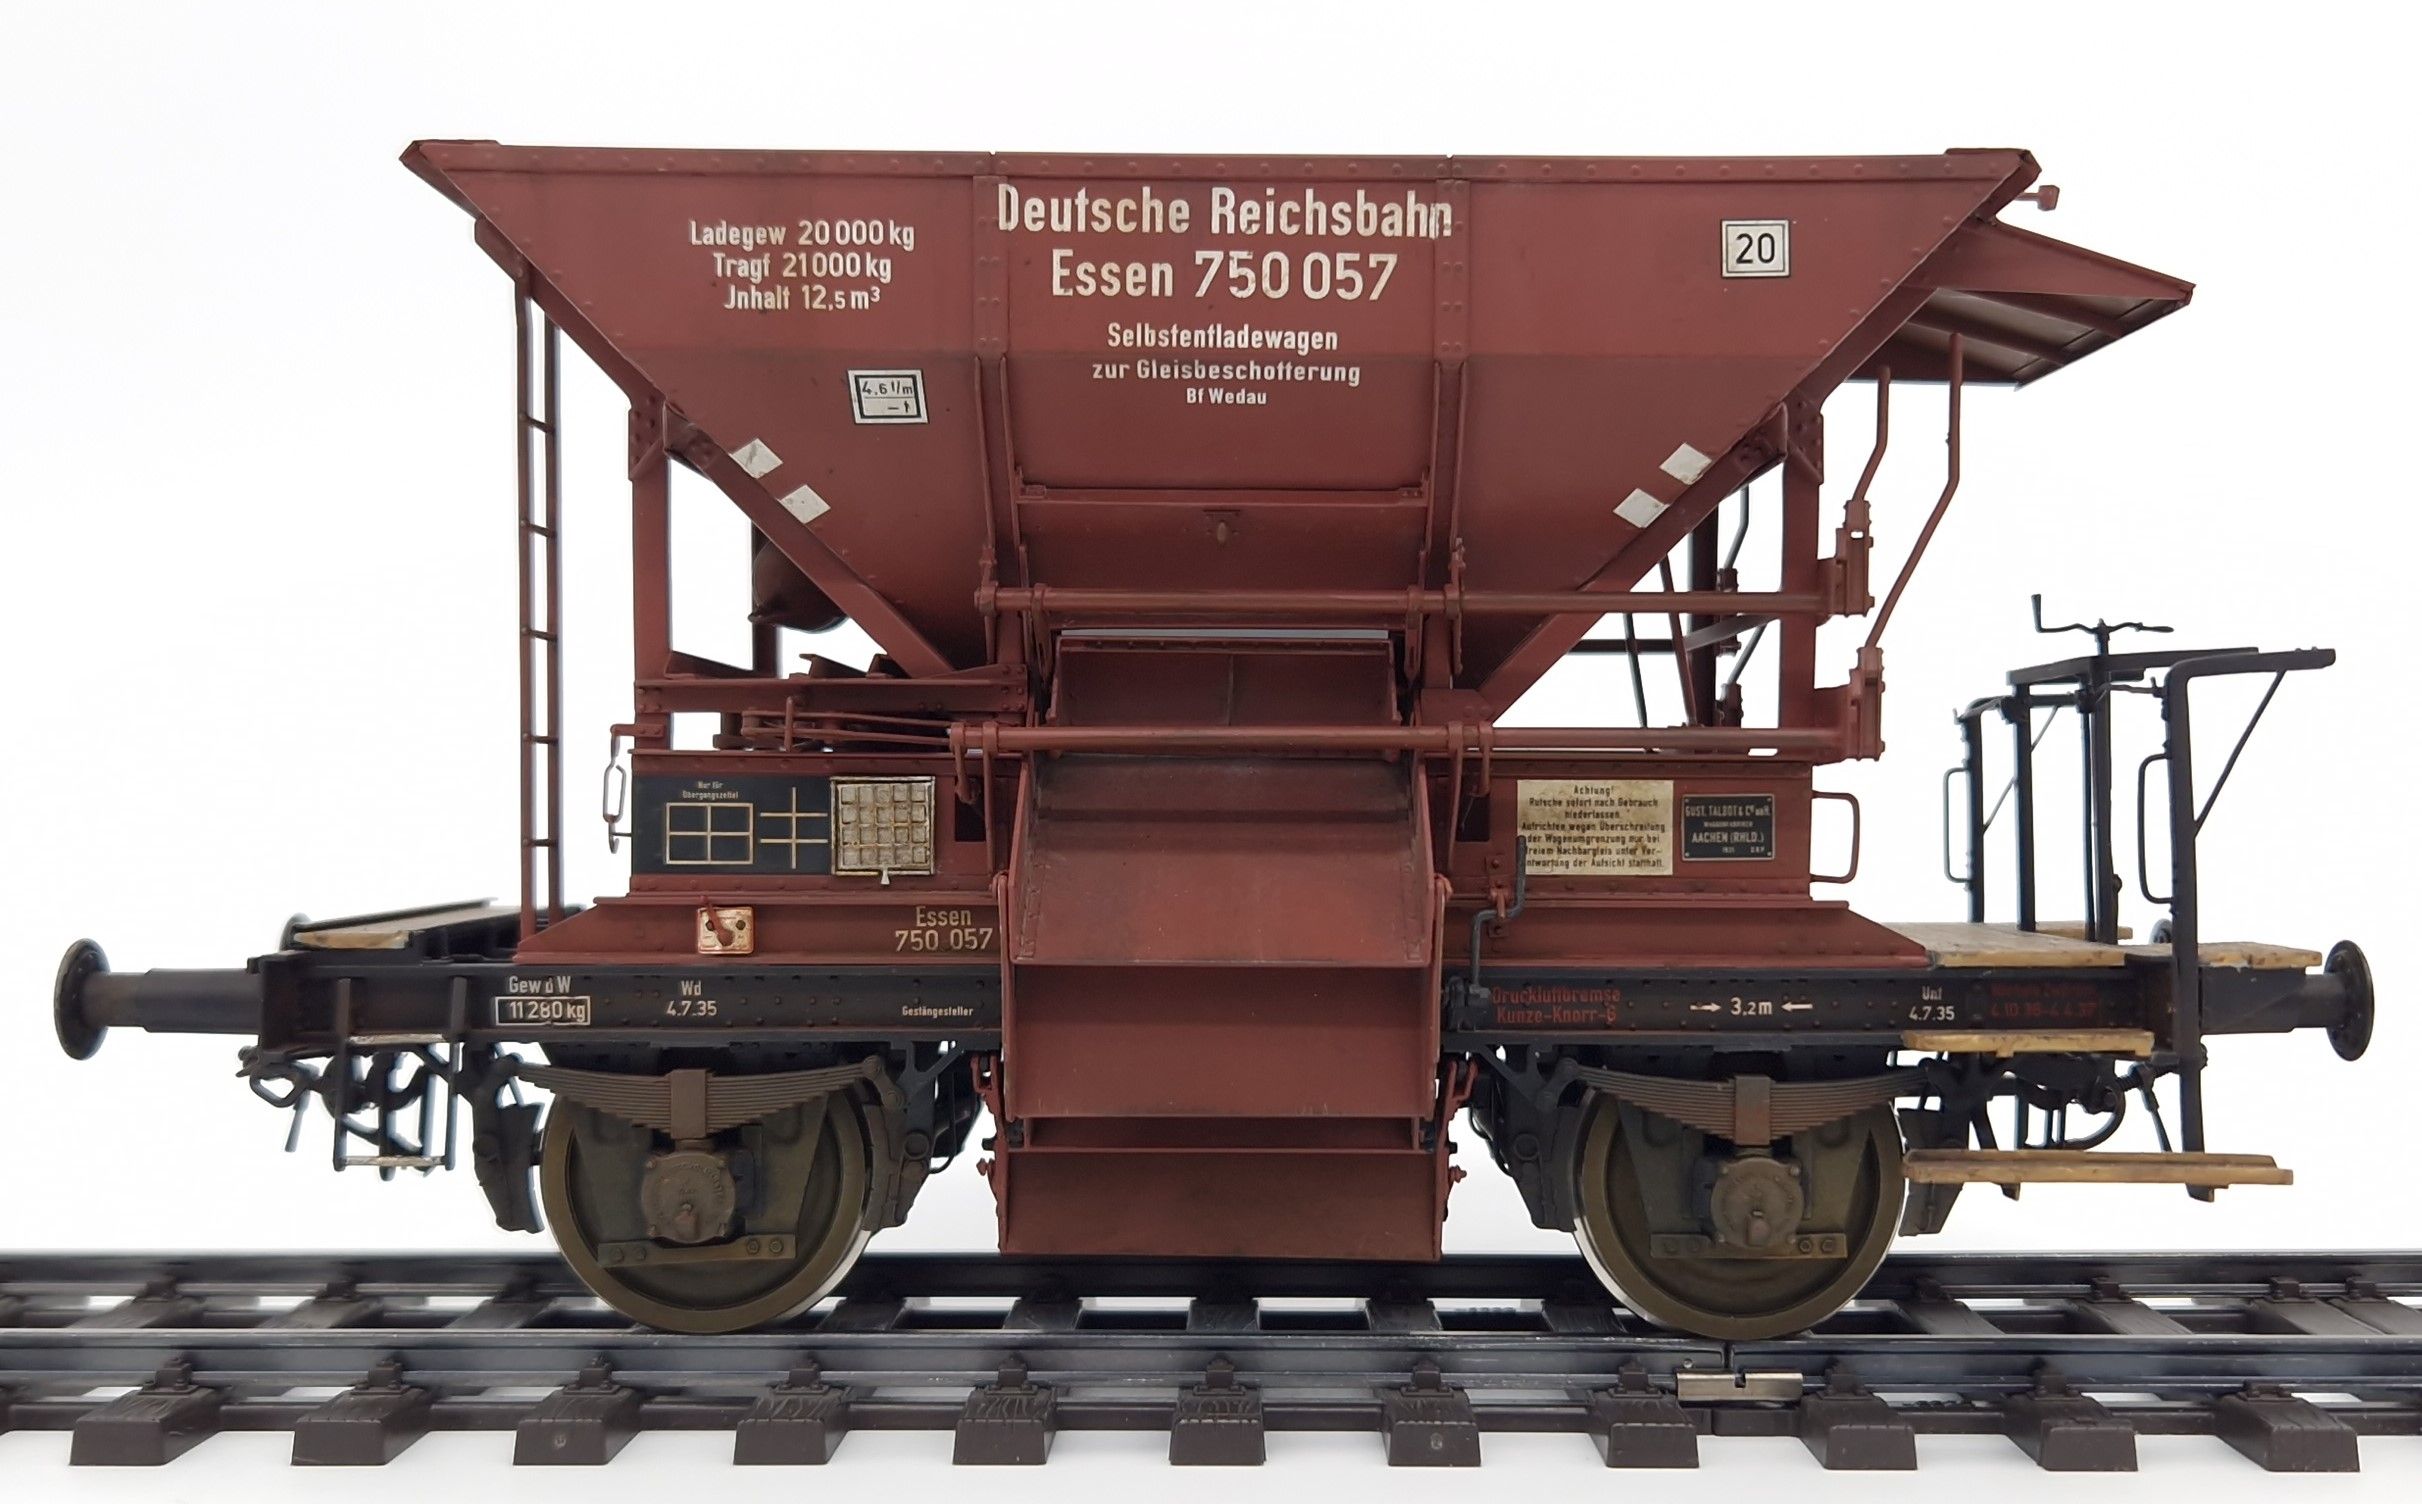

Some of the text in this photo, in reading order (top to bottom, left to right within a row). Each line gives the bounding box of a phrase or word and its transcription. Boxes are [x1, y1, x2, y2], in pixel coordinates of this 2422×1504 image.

[998, 184, 1453, 240] Deutsche Reichsbahn
[689, 219, 787, 252] Ladegew
[1736, 233, 1775, 264] 20
[1052, 248, 1173, 297] Essen
[801, 285, 846, 311] 12,5
[1107, 322, 1338, 356] Selbstentladewagen
[1092, 359, 1360, 387] zur Gleisbeschotterung
[1186, 388, 1267, 405] Bf Wedau
[1529, 797, 1658, 808] Rutsche sofort nach Gebrauch
[1569, 823, 1596, 834] wegen
[1691, 831, 1729, 844] AACHEN
[1527, 833, 1660, 846] der Wagenumgrenzung nur bei
[1572, 858, 1587, 867] der
[1590, 858, 1625, 868] Aufsicht
[916, 905, 972, 927] Essen
[895, 928, 993, 952] 750 057
[509, 975, 541, 994] Gew
[557, 975, 571, 994] W
[681, 980, 702, 996] Wd
[566, 1002, 586, 1023] kg
[666, 1000, 718, 1017] 4.7.35
[902, 1005, 974, 1019] Gestängesteller
[1908, 1005, 1955, 1021] 4.7.35
